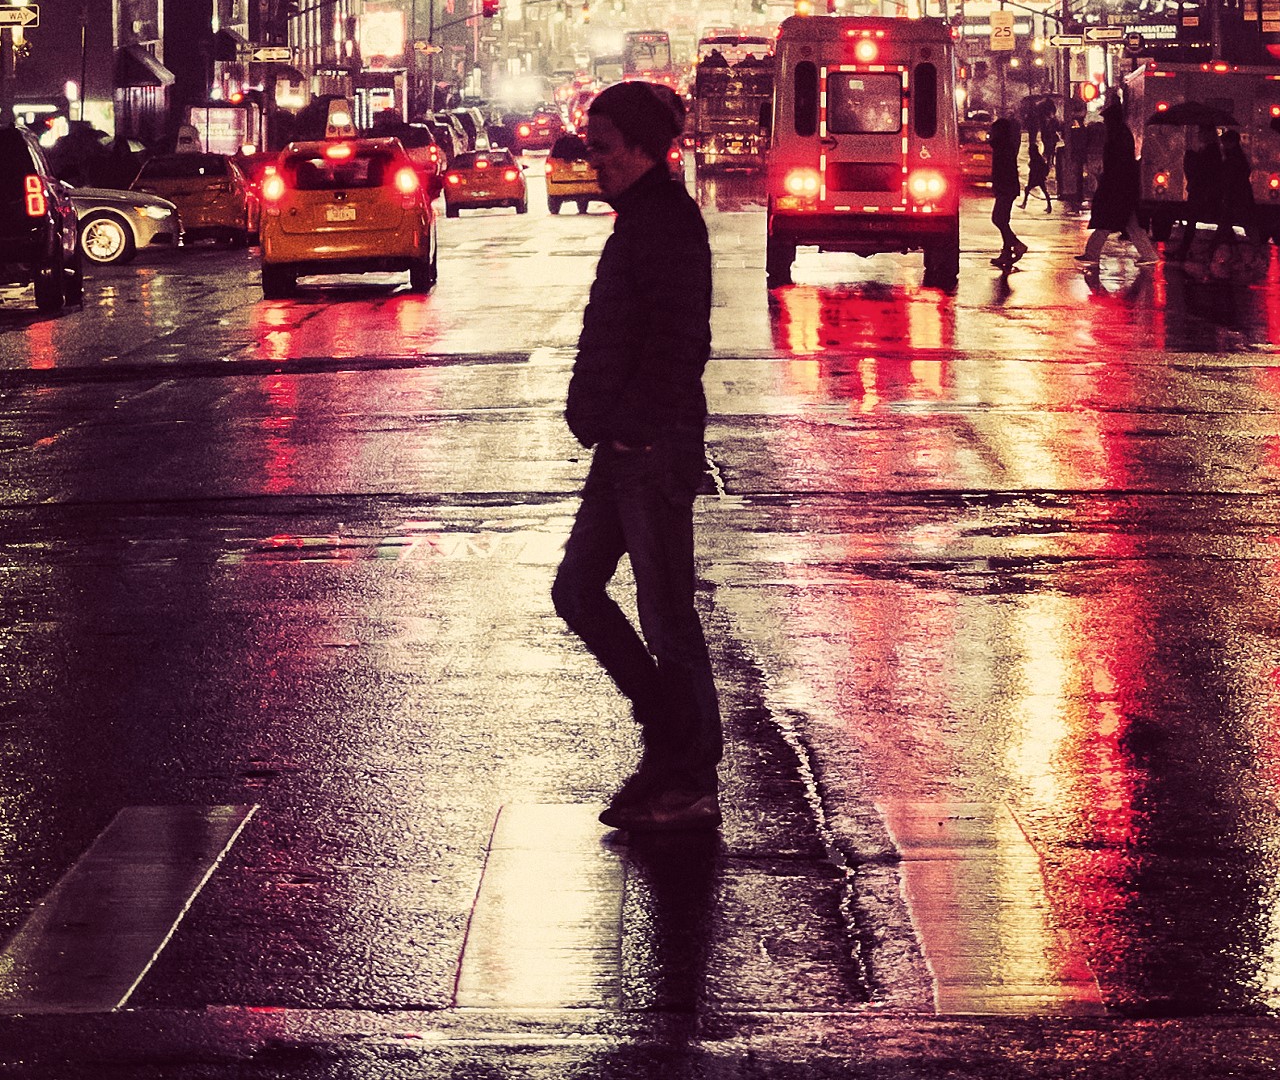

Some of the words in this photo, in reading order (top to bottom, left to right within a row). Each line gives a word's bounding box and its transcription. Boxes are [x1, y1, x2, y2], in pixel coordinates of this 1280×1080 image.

[9, 12, 30, 21] WAY
[994, 26, 1012, 37] 25
[1125, 24, 1177, 34] MANHATTAN
